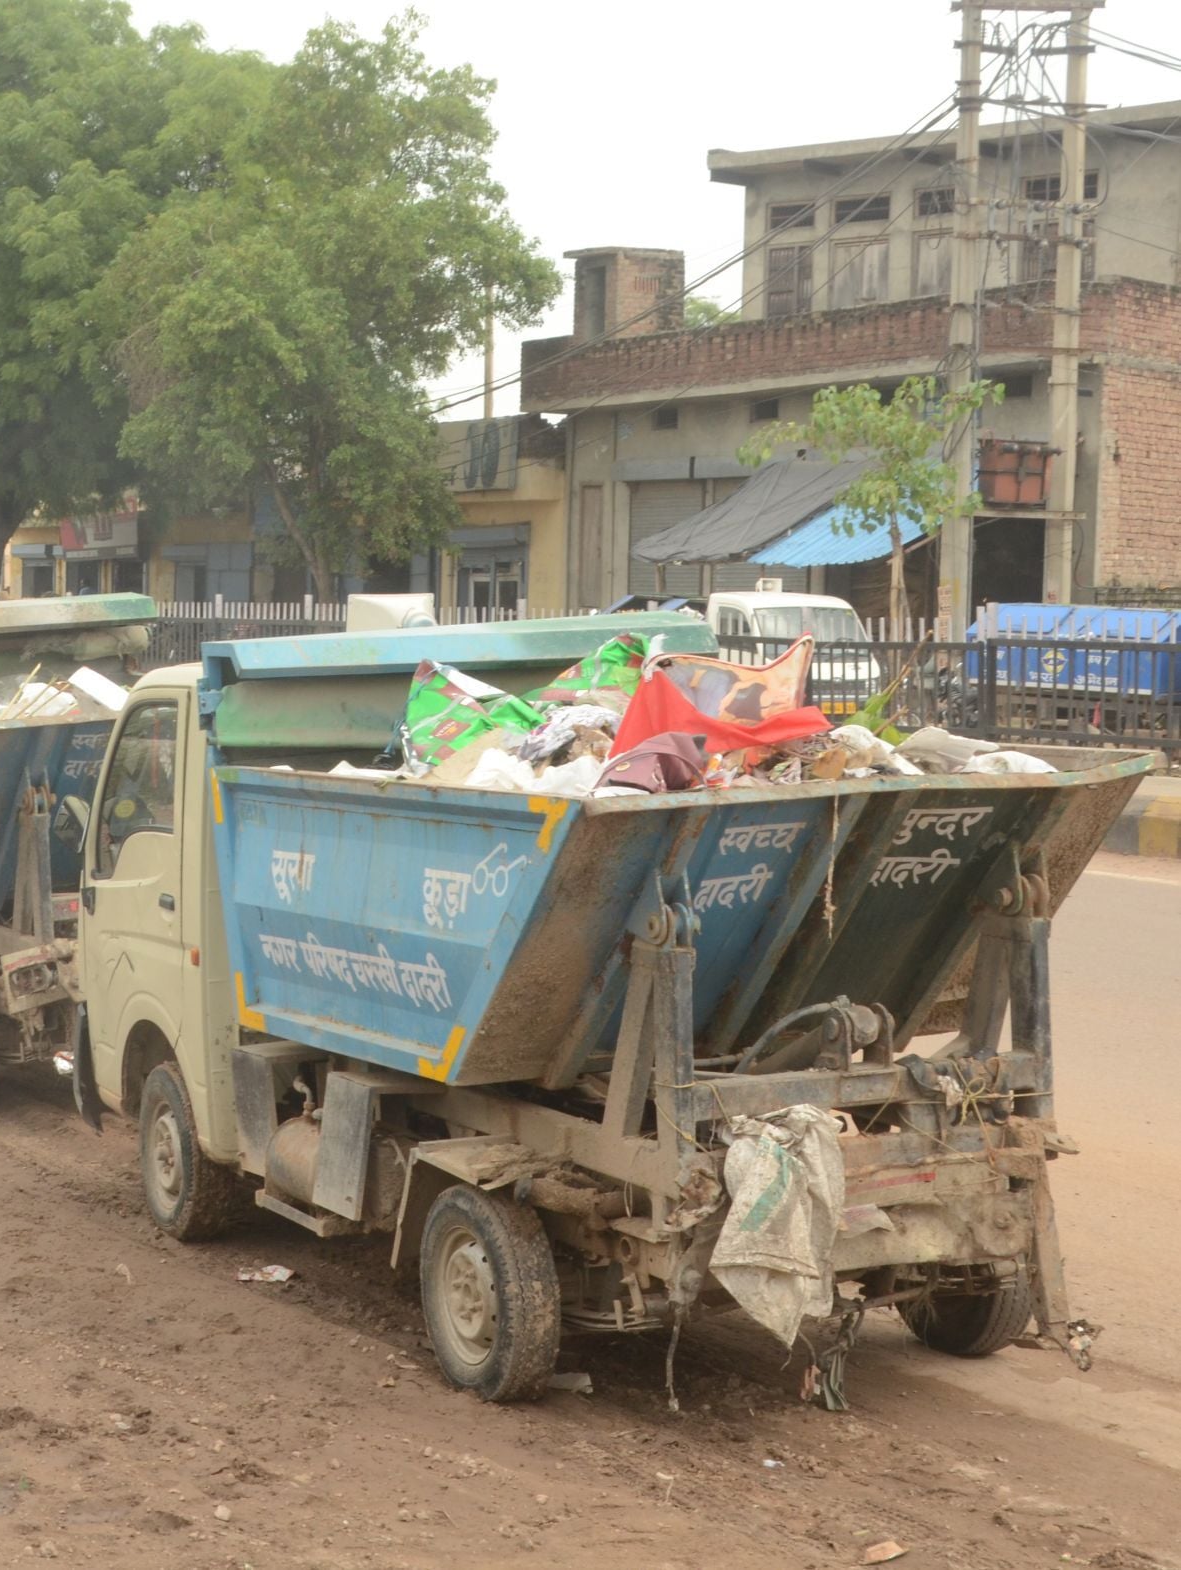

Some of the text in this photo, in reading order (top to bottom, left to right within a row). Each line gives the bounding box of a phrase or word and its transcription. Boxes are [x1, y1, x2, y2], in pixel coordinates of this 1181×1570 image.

[271, 850, 315, 904] सूखा
[693, 863, 775, 913] दादरी
[259, 934, 302, 973] नगर
[397, 952, 453, 1013] दादरी
